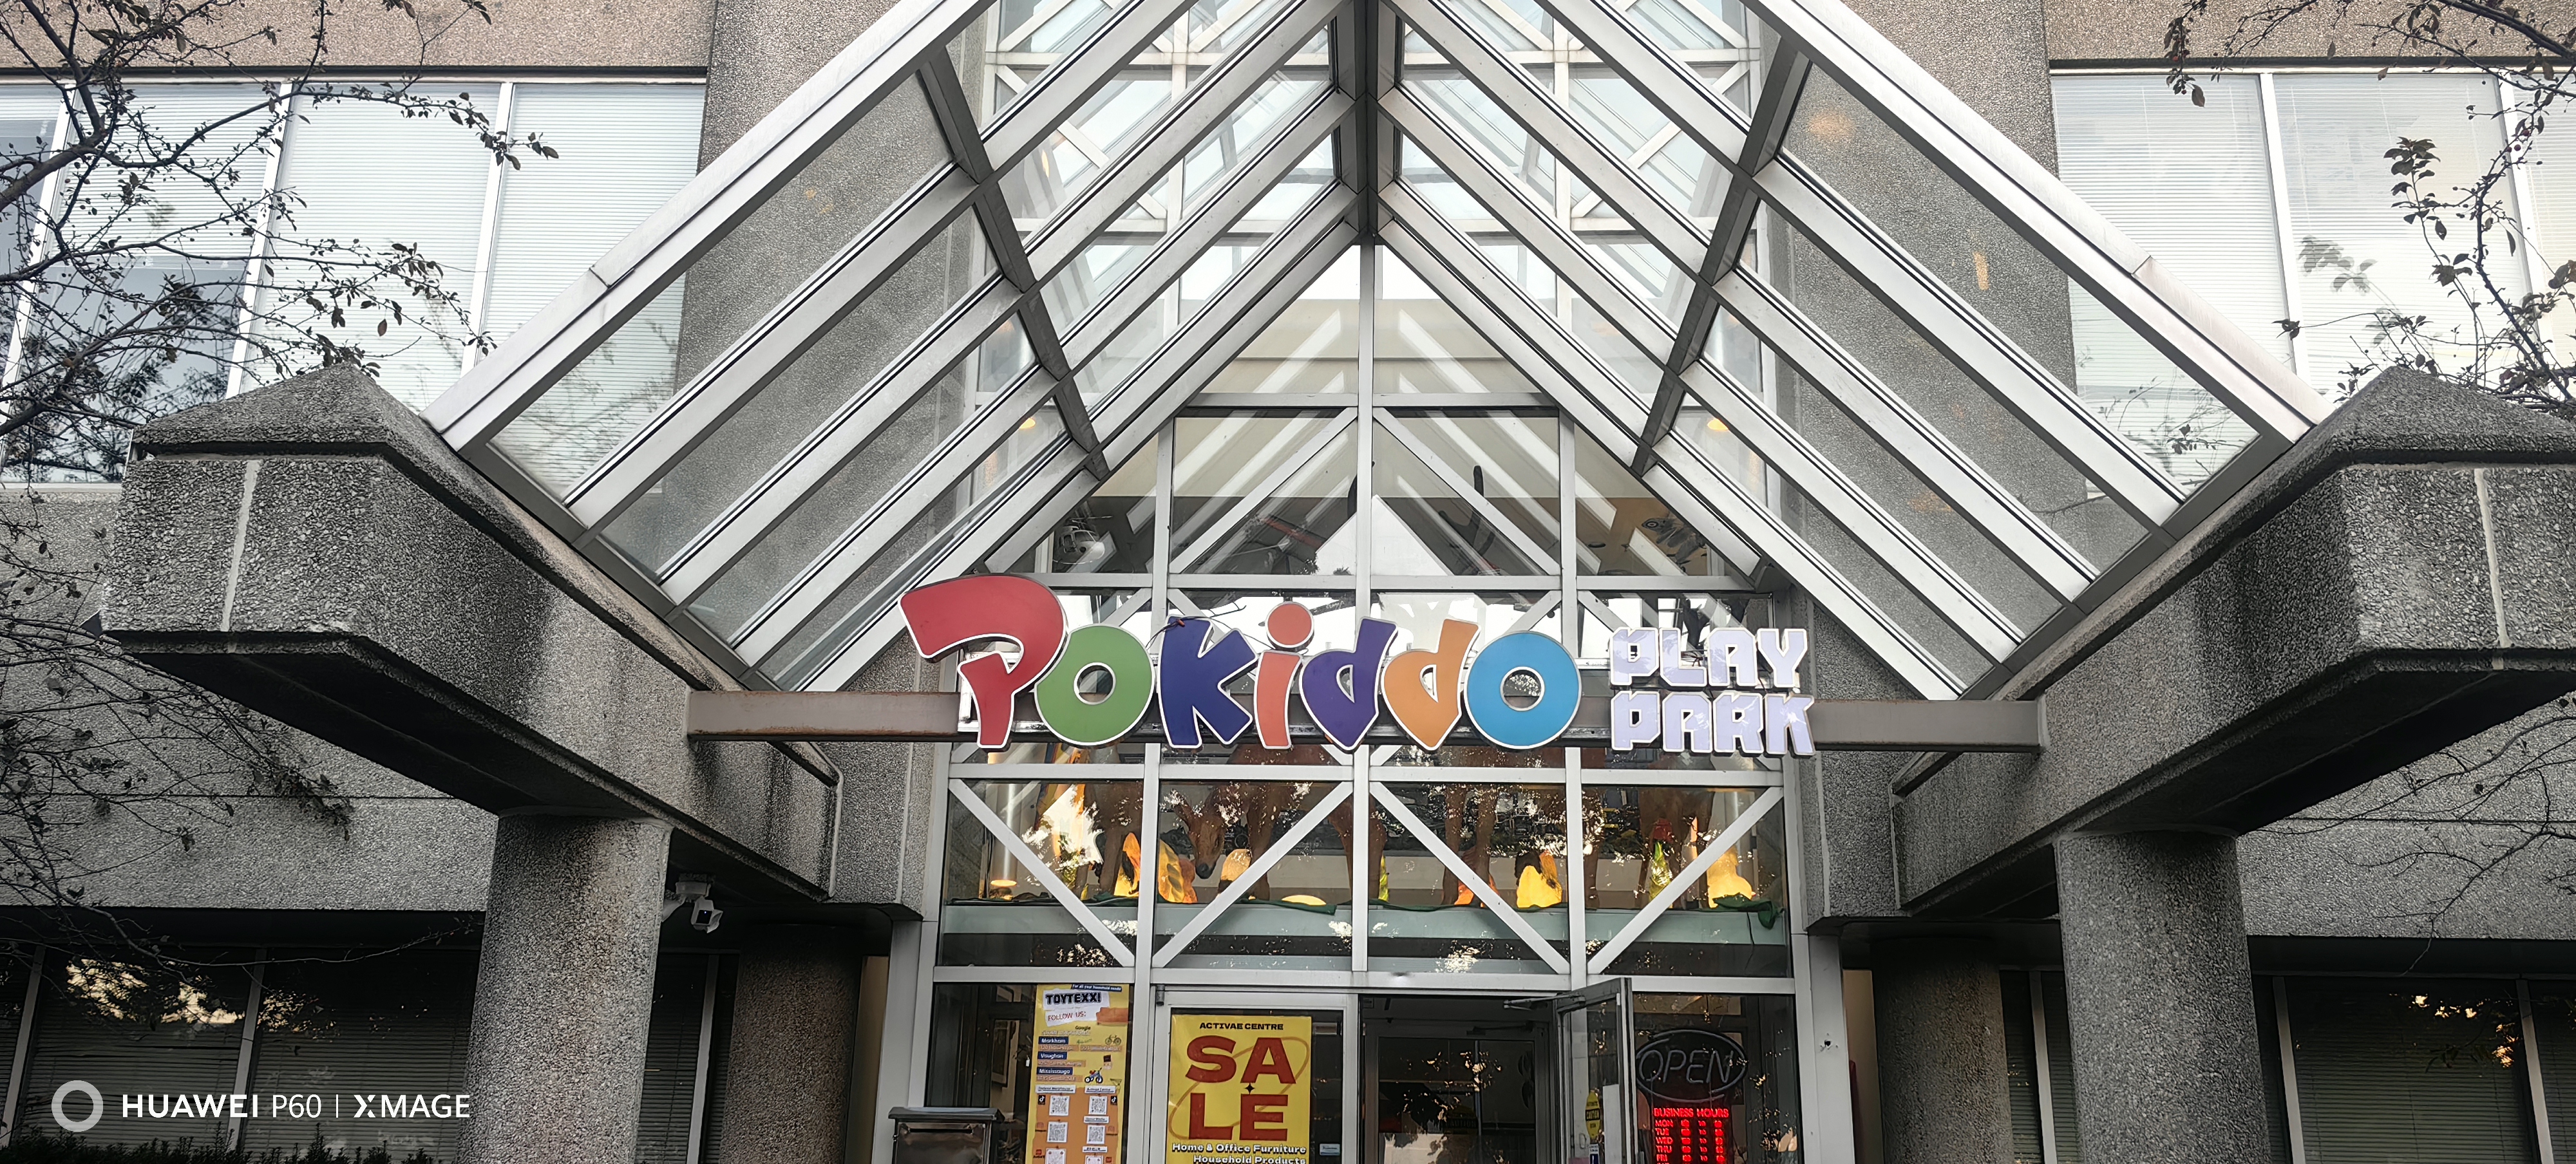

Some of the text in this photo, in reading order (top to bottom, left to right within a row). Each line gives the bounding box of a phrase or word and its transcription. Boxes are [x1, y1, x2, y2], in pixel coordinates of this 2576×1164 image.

[1611, 627, 1808, 688] PLAY
[1611, 690, 1815, 756] PARK
[1048, 1012, 1073, 1021] FOLLOW
[1639, 1049, 1734, 1084] OPEN
[1654, 1108, 1729, 1118] BUSINESS HOURS
[1655, 1119, 1673, 1127] MON
[1172, 1143, 1307, 1154] Home & Office Furniture
[1656, 1145, 1672, 1153] THU
[1193, 1155, 1252, 1164] Household
